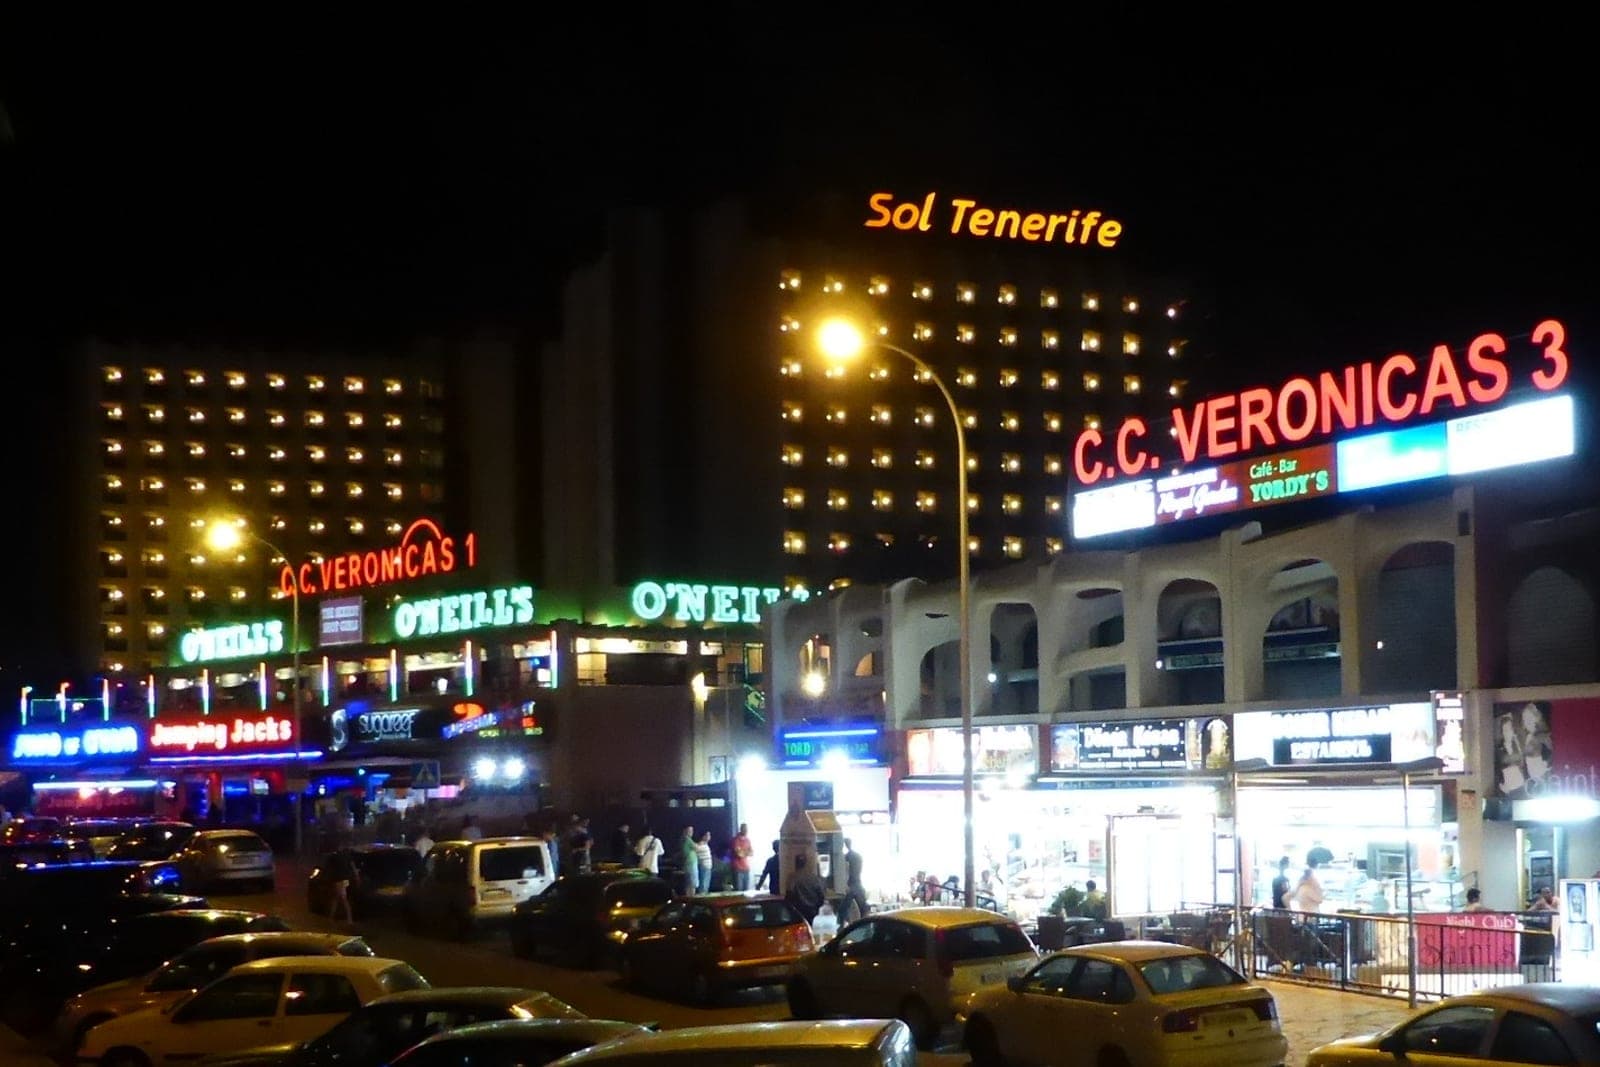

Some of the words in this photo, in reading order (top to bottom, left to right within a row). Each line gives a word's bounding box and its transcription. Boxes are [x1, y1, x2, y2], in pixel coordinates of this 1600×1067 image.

[865, 192, 936, 231] Sol
[951, 199, 1122, 247] Tenerife
[1074, 417, 1159, 484] C.C.
[1173, 333, 1509, 462] VERONICAS
[1531, 319, 1568, 390] 3
[320, 537, 455, 591] VERONICAS
[465, 532, 475, 567] 1
[231, 717, 292, 743] Jacks
[1481, 914, 1514, 930] Club
